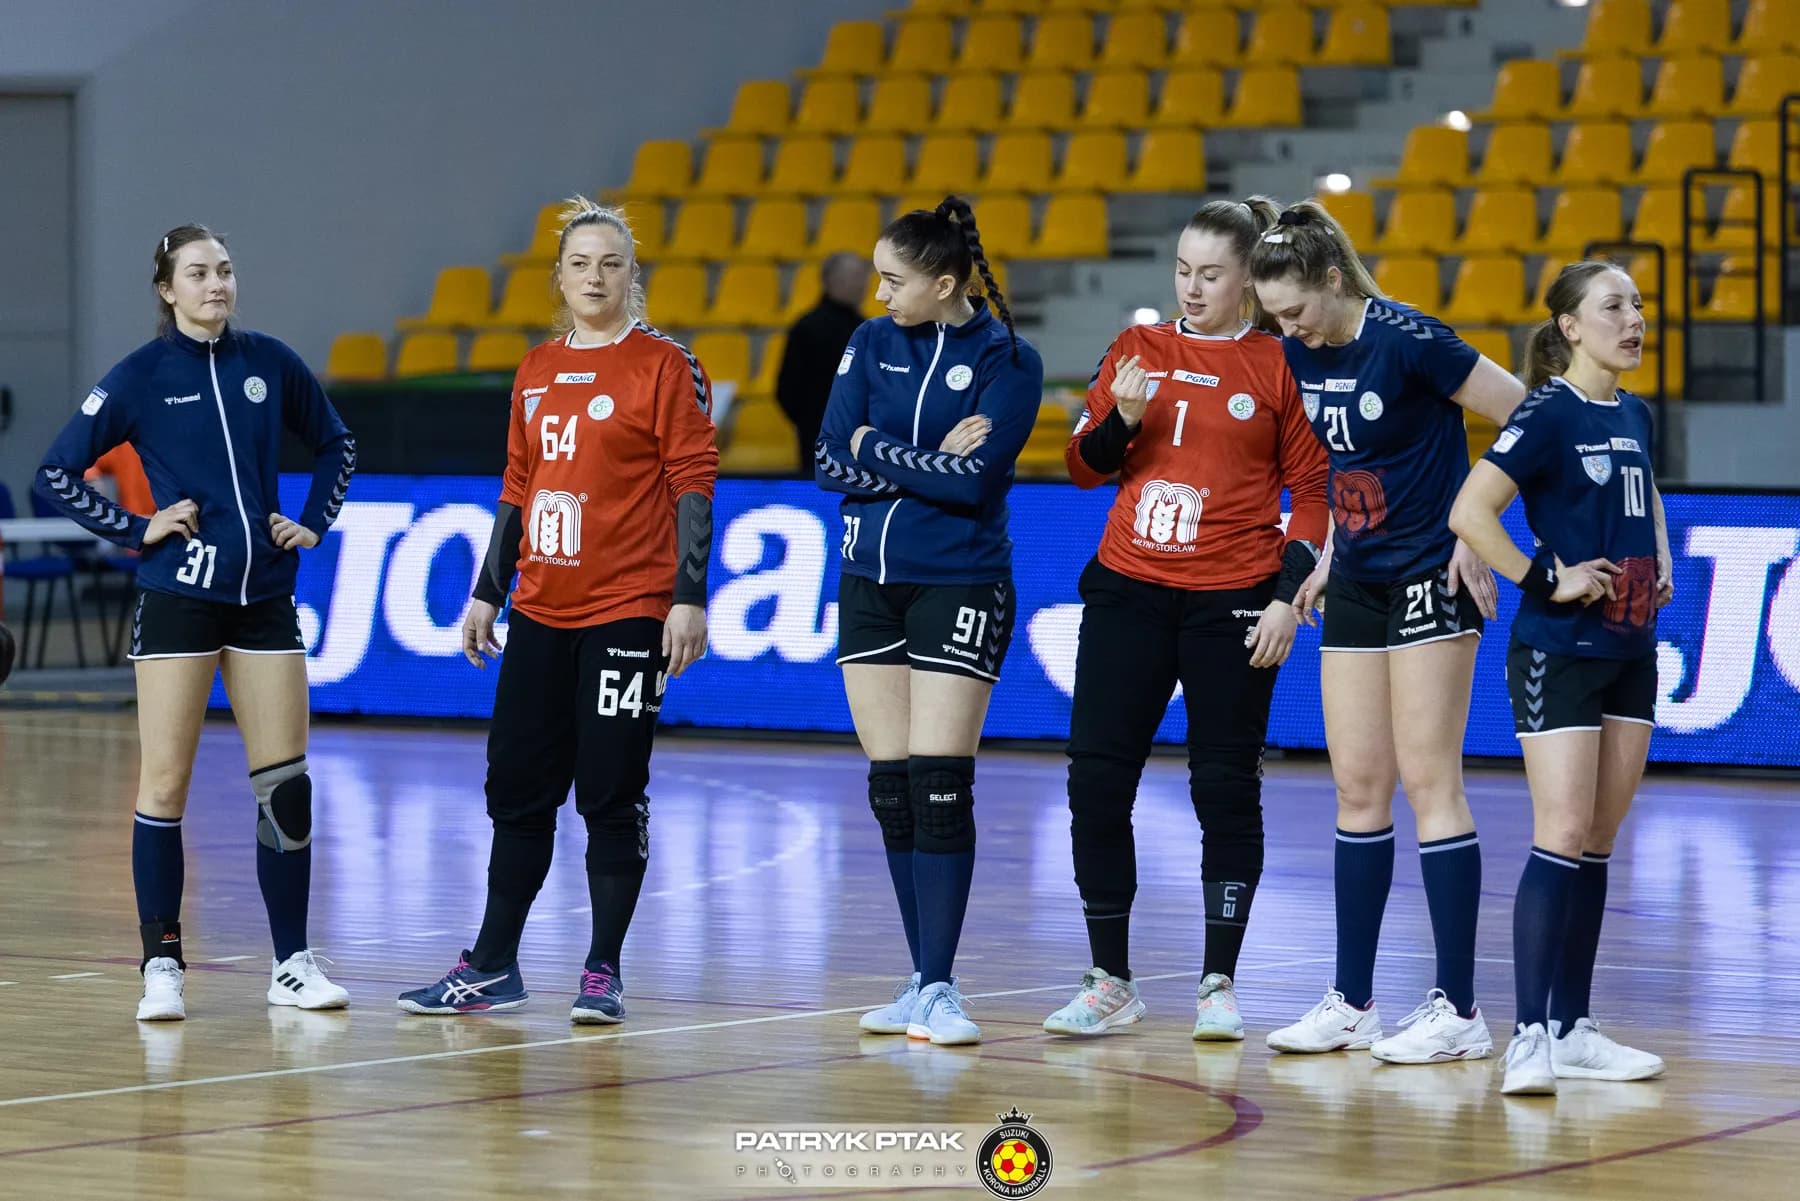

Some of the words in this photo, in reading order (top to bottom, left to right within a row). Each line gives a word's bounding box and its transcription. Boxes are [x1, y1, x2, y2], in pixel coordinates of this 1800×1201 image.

[1185, 374, 1217, 385] PGNiG
[540, 415, 578, 461] 64
[1172, 400, 1189, 446] 1
[1324, 406, 1356, 452] 21
[1620, 465, 1646, 517] 10
[176, 538, 217, 589] 31
[1156, 542, 1196, 552] STOISŁAW
[1404, 579, 1434, 622] 21
[952, 606, 988, 648] 91
[617, 648, 650, 658] hummel
[597, 669, 644, 718] 64
[929, 792, 957, 802] SELECT
